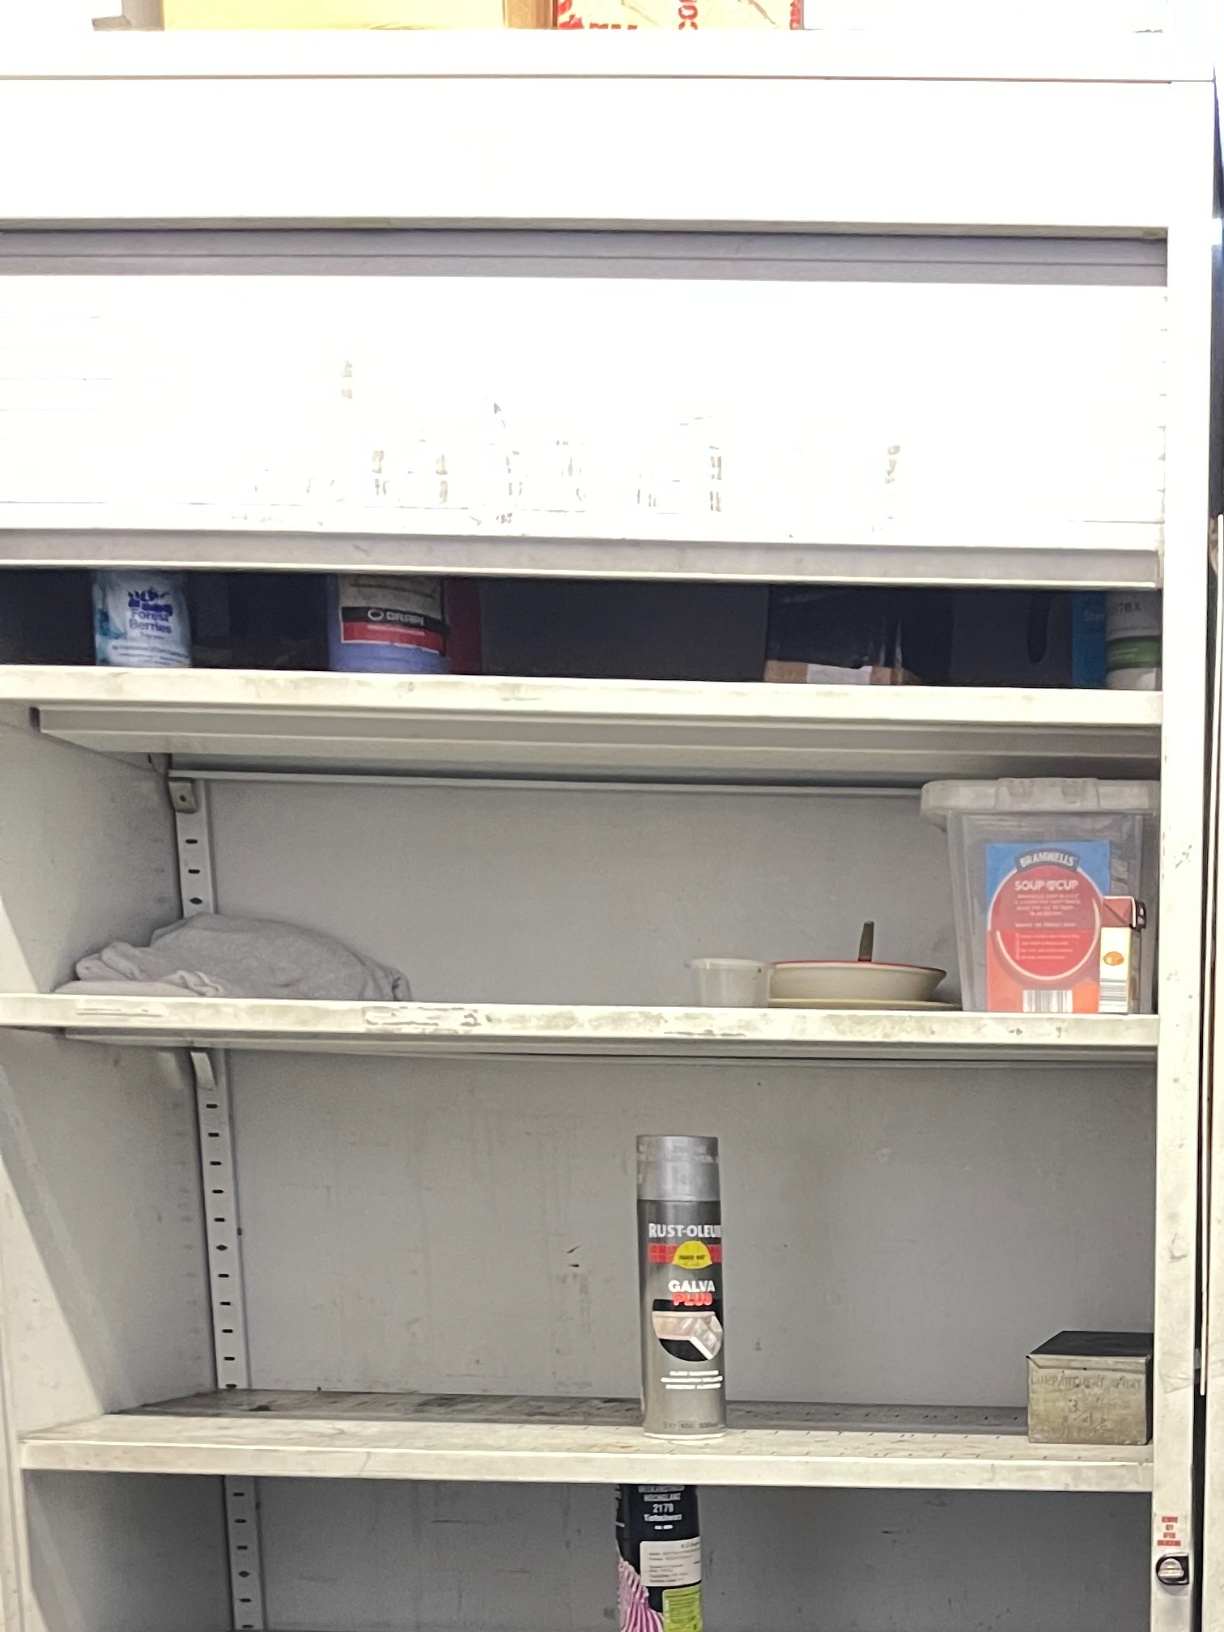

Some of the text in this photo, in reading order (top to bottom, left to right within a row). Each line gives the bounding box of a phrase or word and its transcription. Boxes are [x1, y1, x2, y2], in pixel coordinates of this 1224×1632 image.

[130, 620, 172, 634] Berries
[1020, 851, 1074, 867] BRAMWELLS
[1015, 879, 1079, 891] SOUP CUP
[668, 1280, 716, 1293] GALVA
[672, 1293, 713, 1306] PLUS
